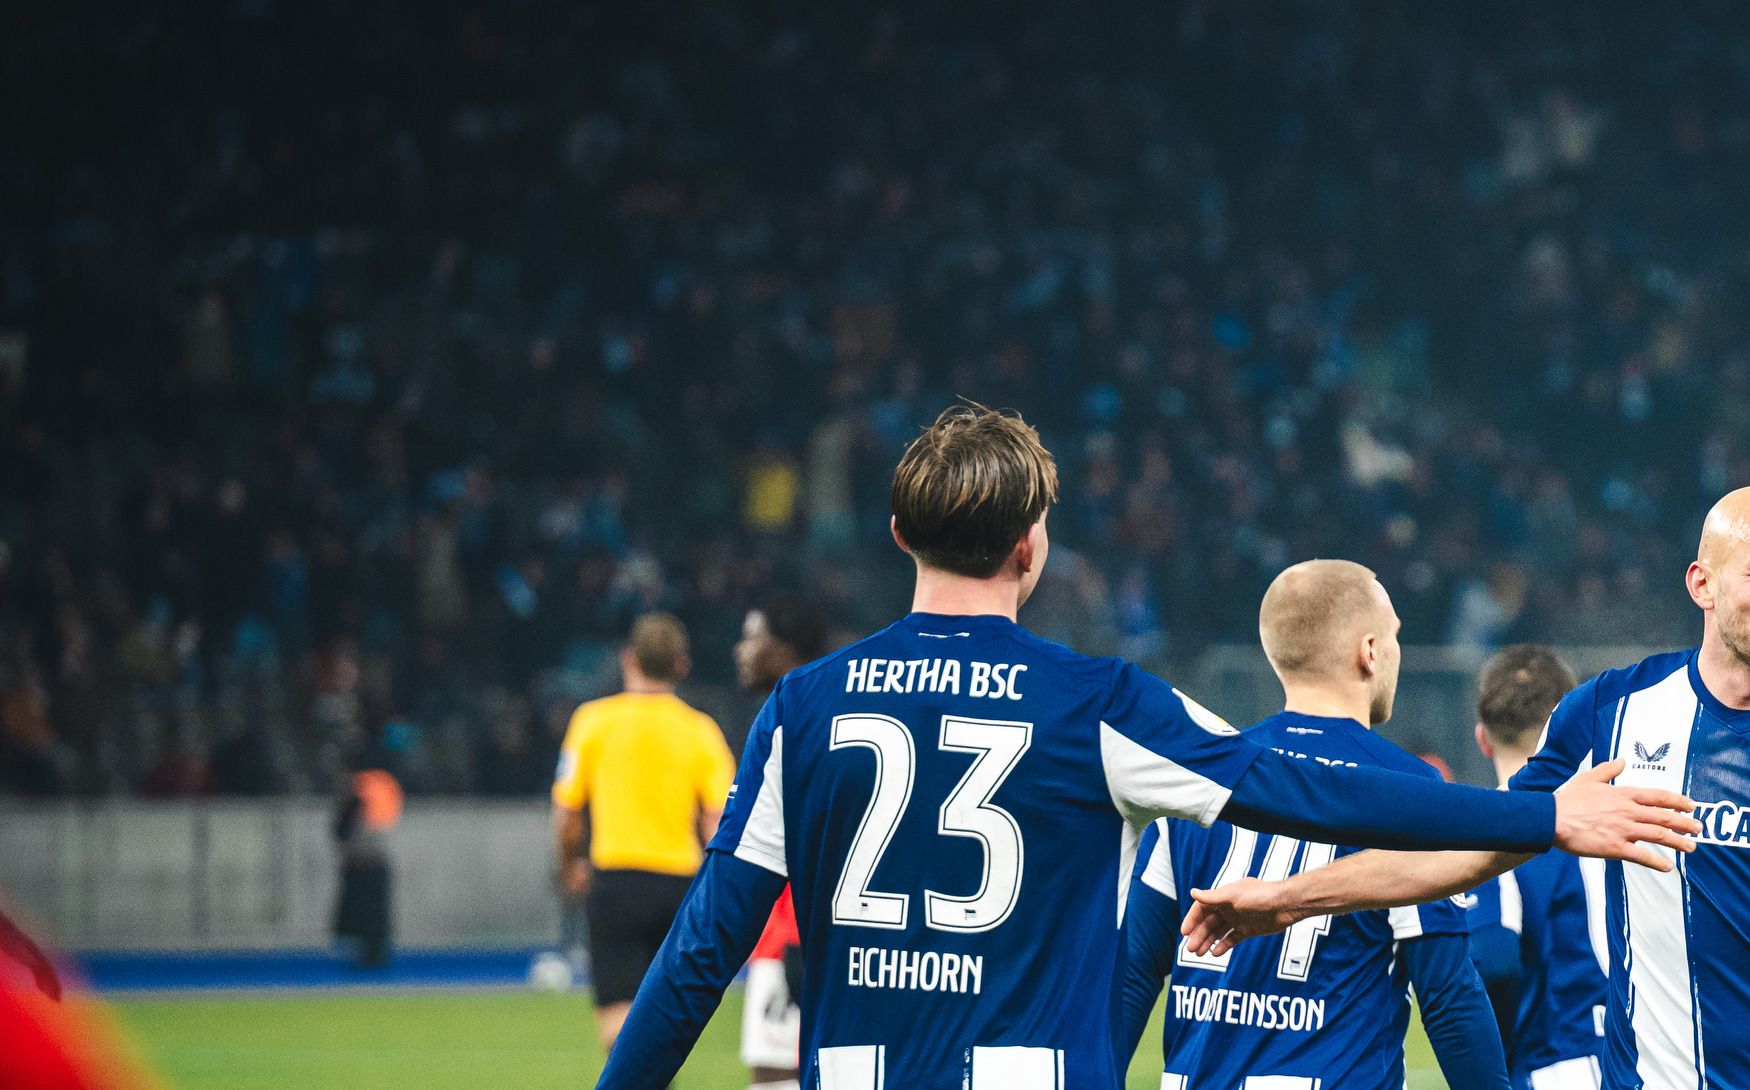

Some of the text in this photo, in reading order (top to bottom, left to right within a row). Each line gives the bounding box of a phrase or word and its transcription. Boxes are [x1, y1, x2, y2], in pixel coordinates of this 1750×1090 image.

[846, 658, 1027, 700] HERTHA BSC
[829, 713, 1033, 933] 23
[848, 946, 984, 995] EICHHORN
